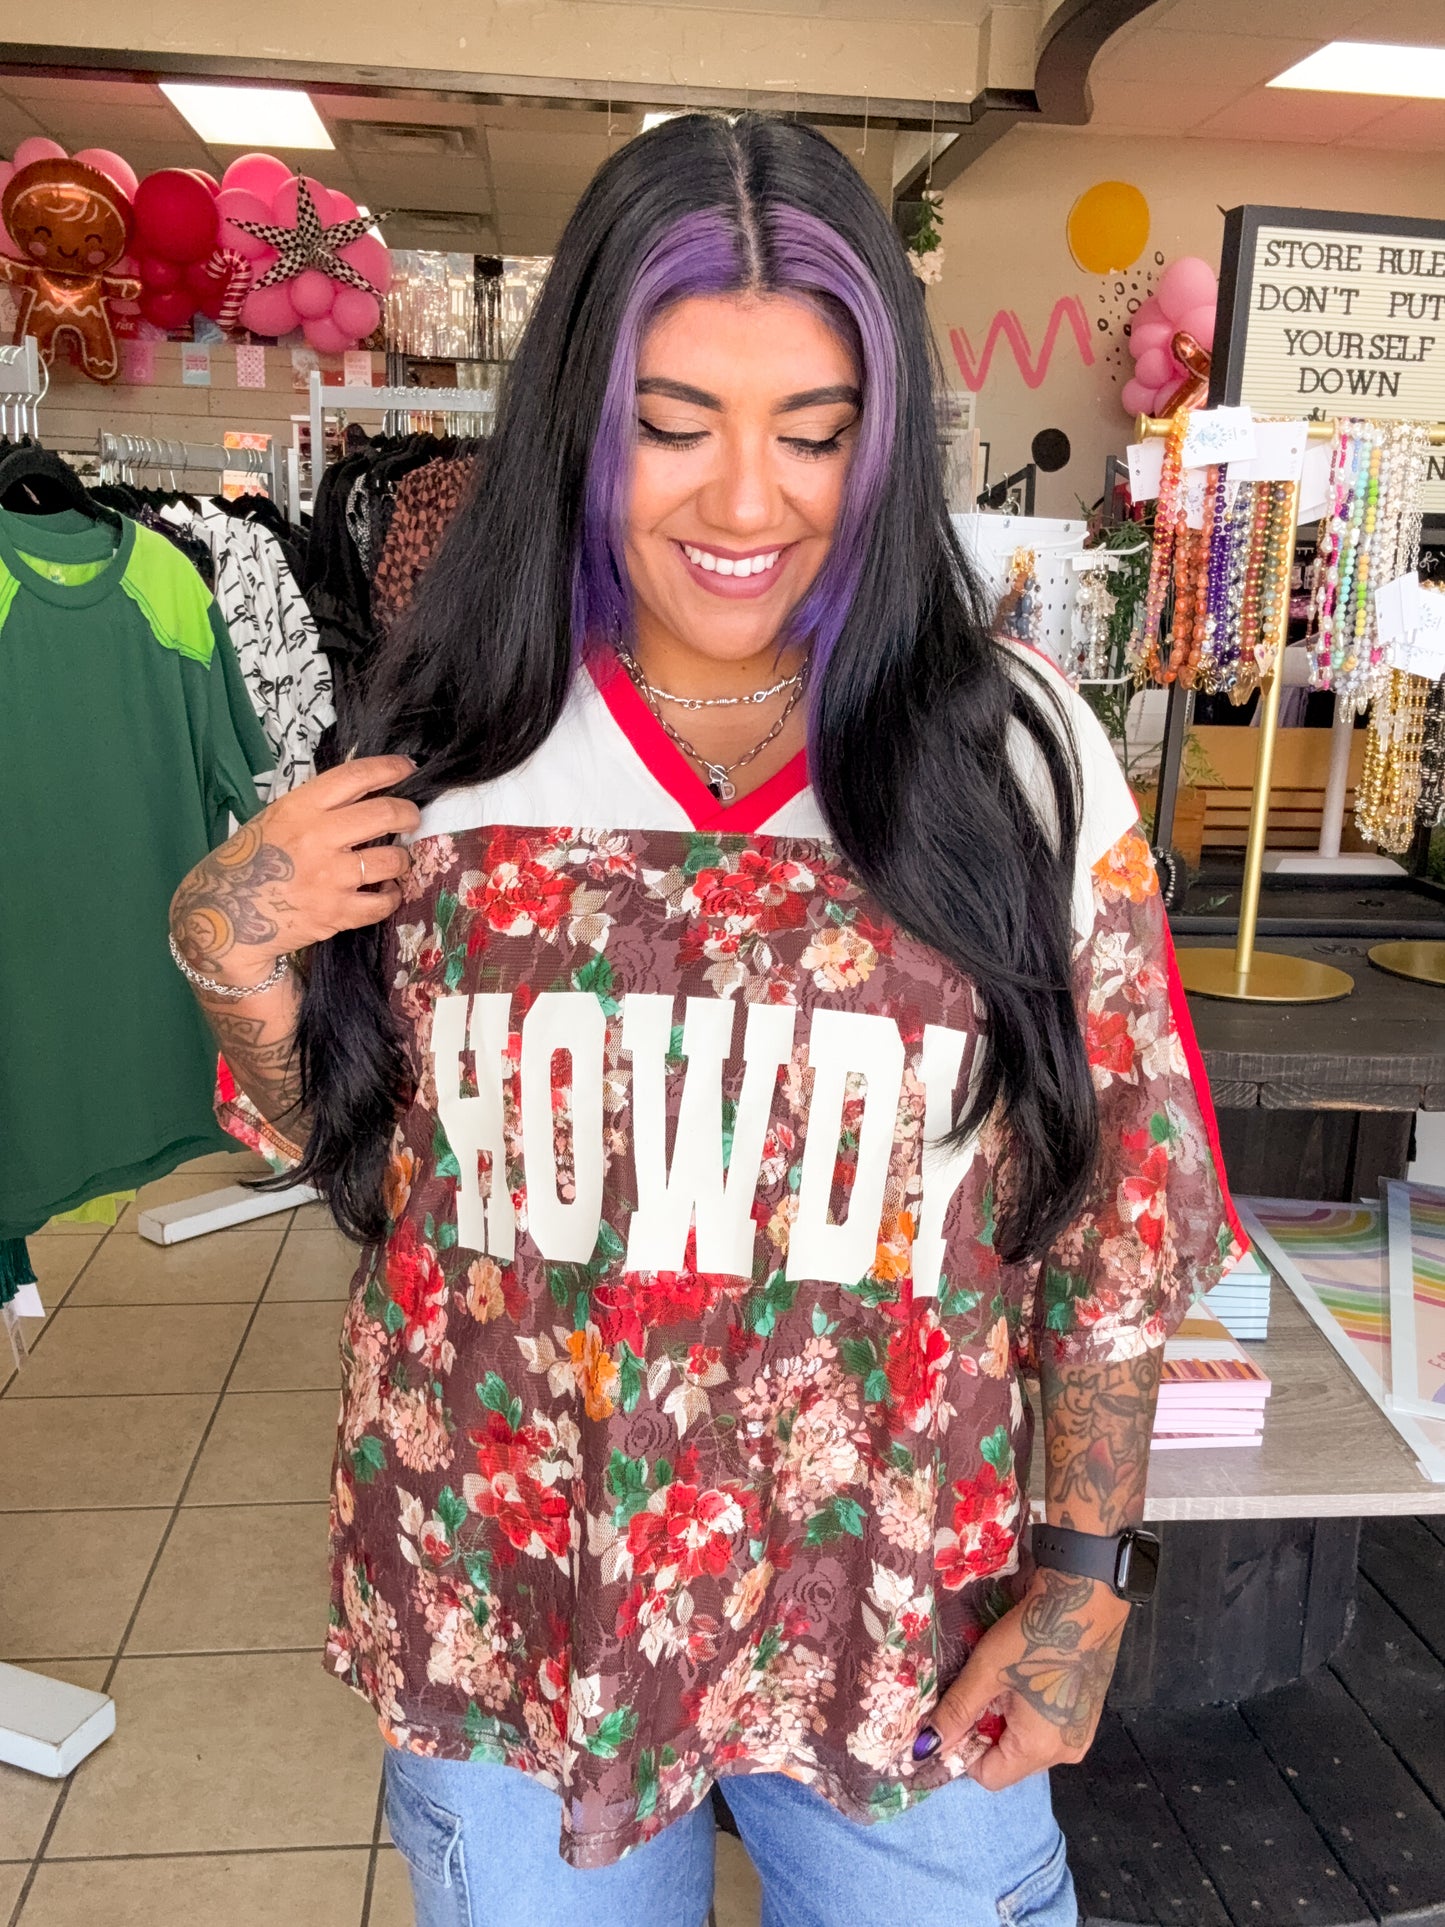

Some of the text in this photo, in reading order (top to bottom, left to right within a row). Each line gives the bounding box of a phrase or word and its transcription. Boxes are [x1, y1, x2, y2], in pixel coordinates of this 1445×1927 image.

[1264, 239, 1445, 277] STORE RULE
[1257, 283, 1445, 321] DON'T PUT
[1283, 328, 1436, 362] YOURSELF
[1297, 367, 1401, 398] DOWN
[430, 992, 988, 1297] HOWDY
